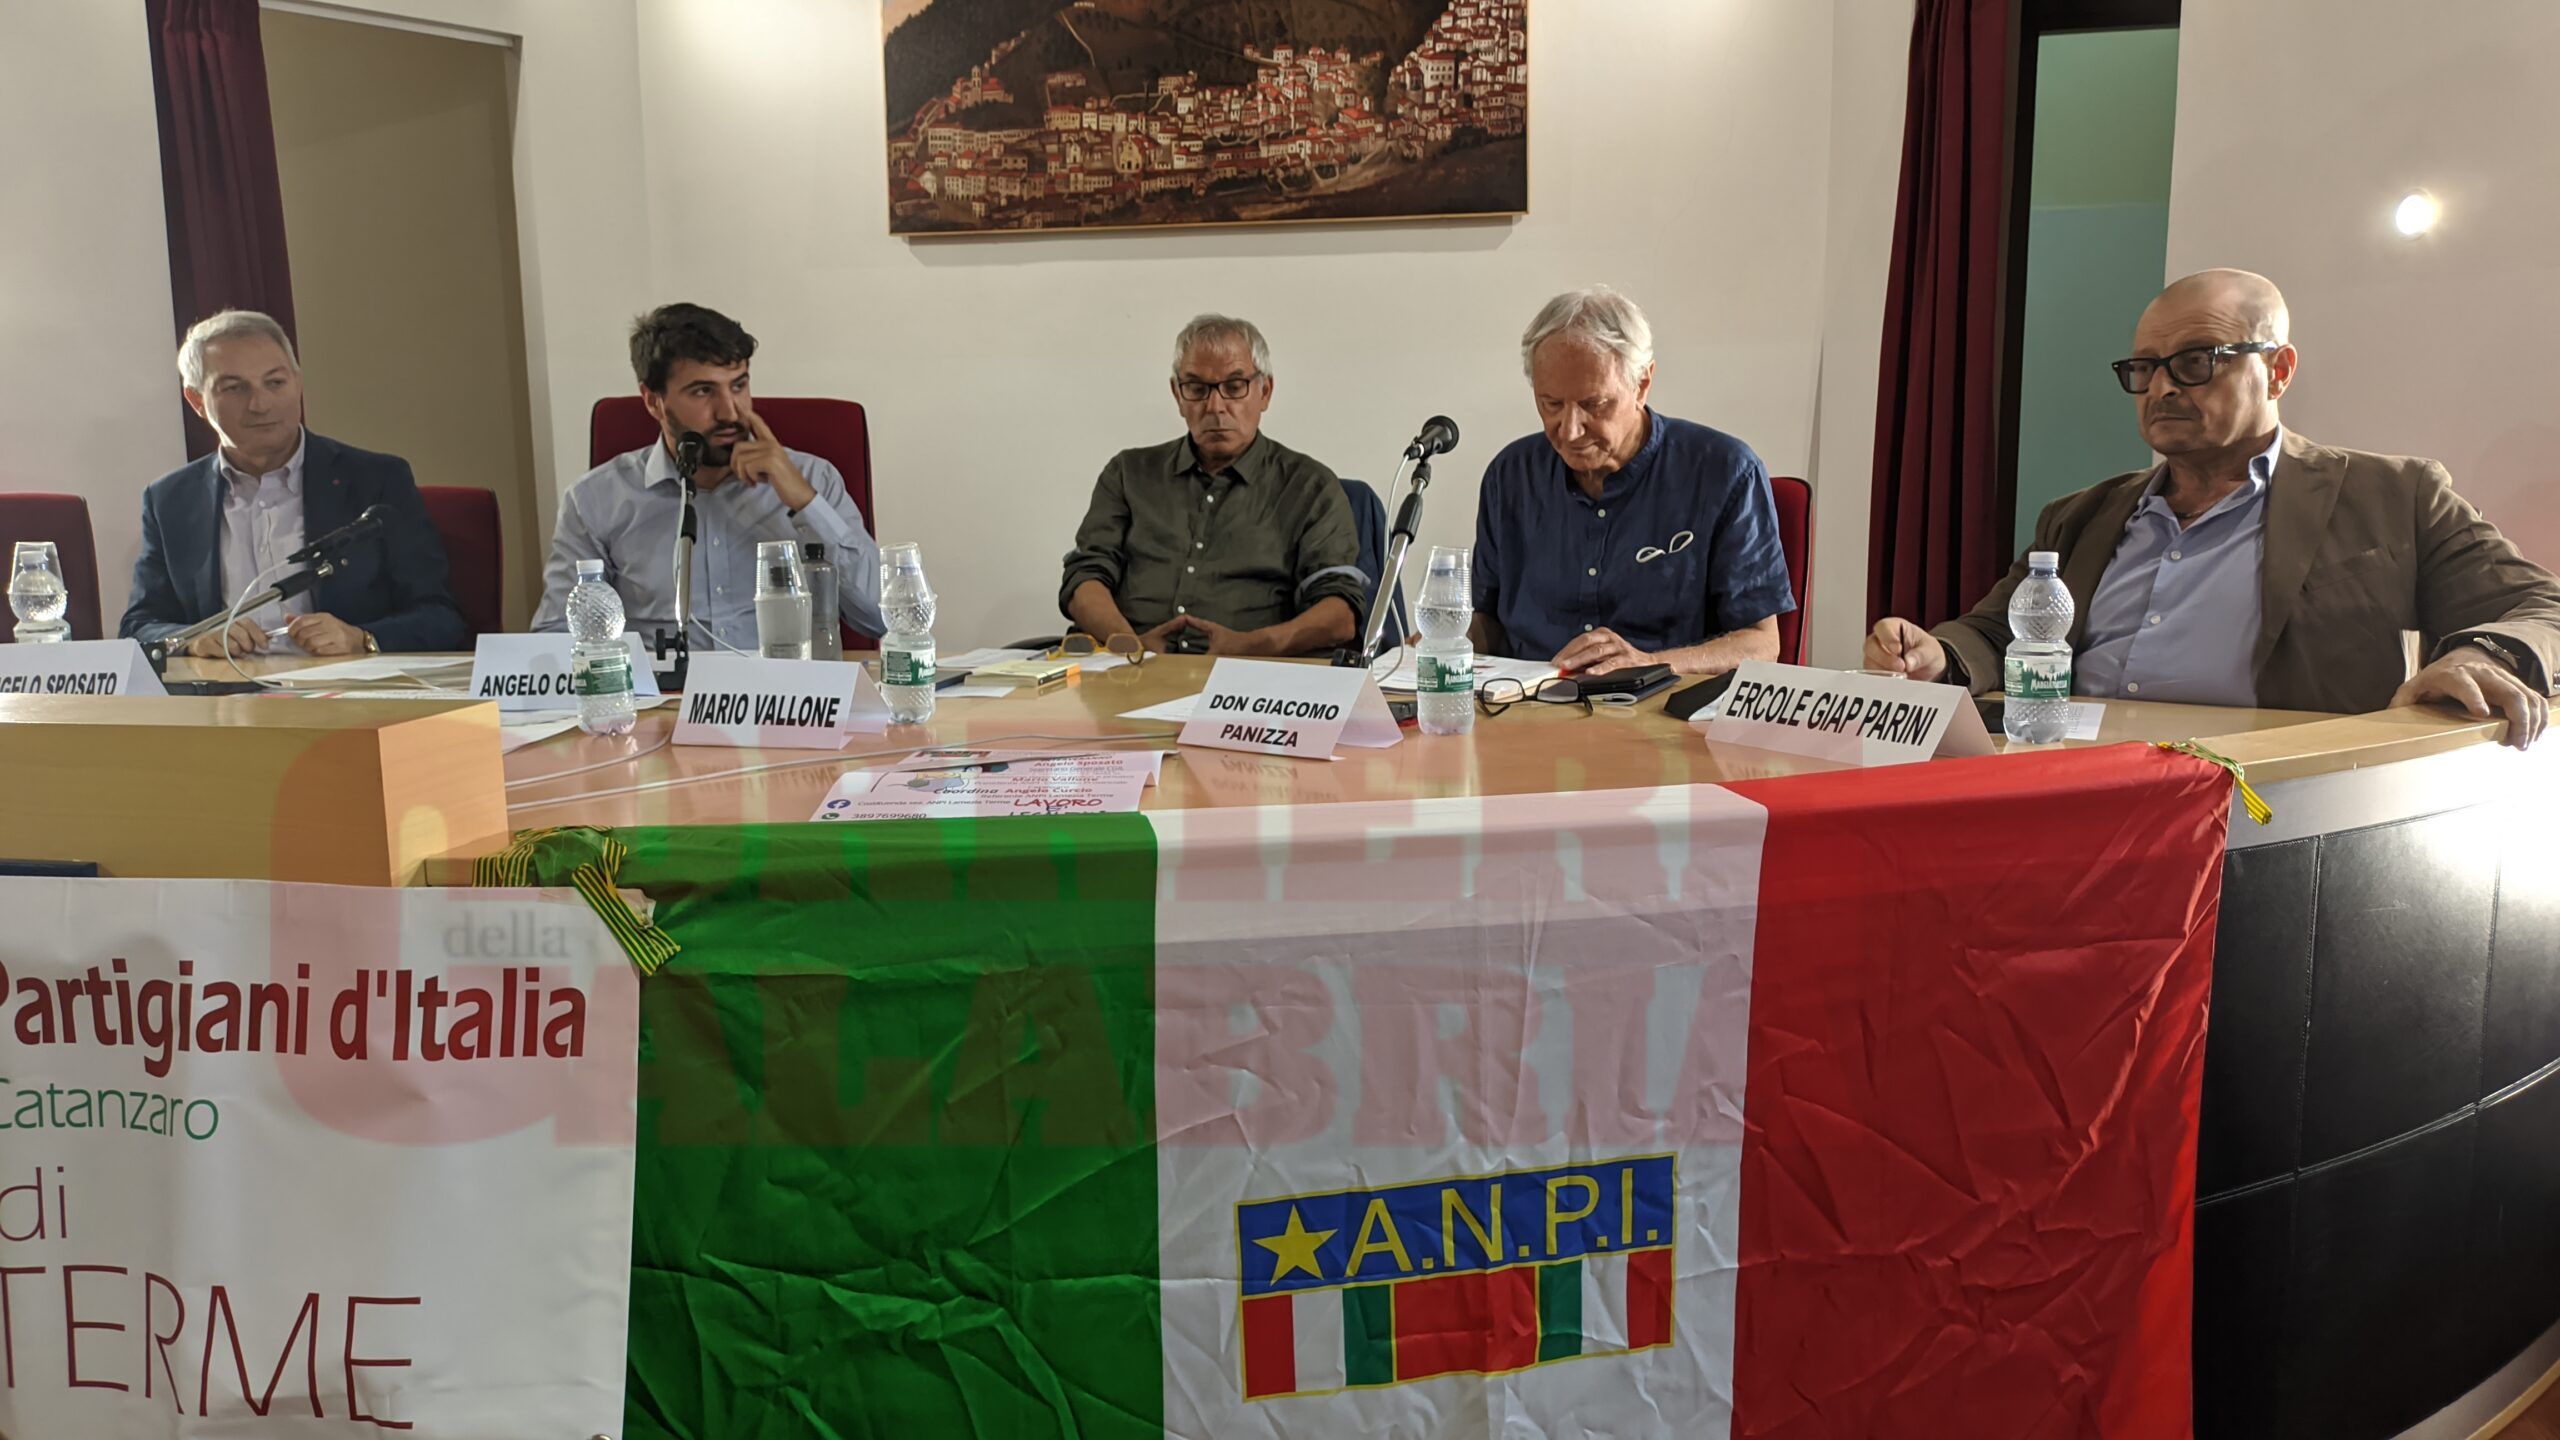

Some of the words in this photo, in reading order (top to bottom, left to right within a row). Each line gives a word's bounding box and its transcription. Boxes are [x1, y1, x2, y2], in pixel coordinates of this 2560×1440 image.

[47, 672, 117, 695] SPOSATO
[480, 673, 550, 697] ANGELO
[688, 693, 748, 725] MARIO
[754, 694, 840, 728] VALLONE
[1209, 694, 1249, 712] DON
[1252, 697, 1340, 721] GIACOMO
[1726, 680, 1813, 727] ERCOLE
[1807, 692, 1864, 734] GIAP
[1856, 699, 1938, 747] PARINI
[1220, 723, 1298, 748] PANIZZA
[1014, 798, 1103, 807] LAVORO
[0, 957, 310, 1078] artigiani
[329, 966, 587, 1062] d'Italia
[0, 1165, 68, 1242] di
[1346, 1167, 1658, 1278] A.N.P.I.
[0, 1264, 422, 1430] TERME
